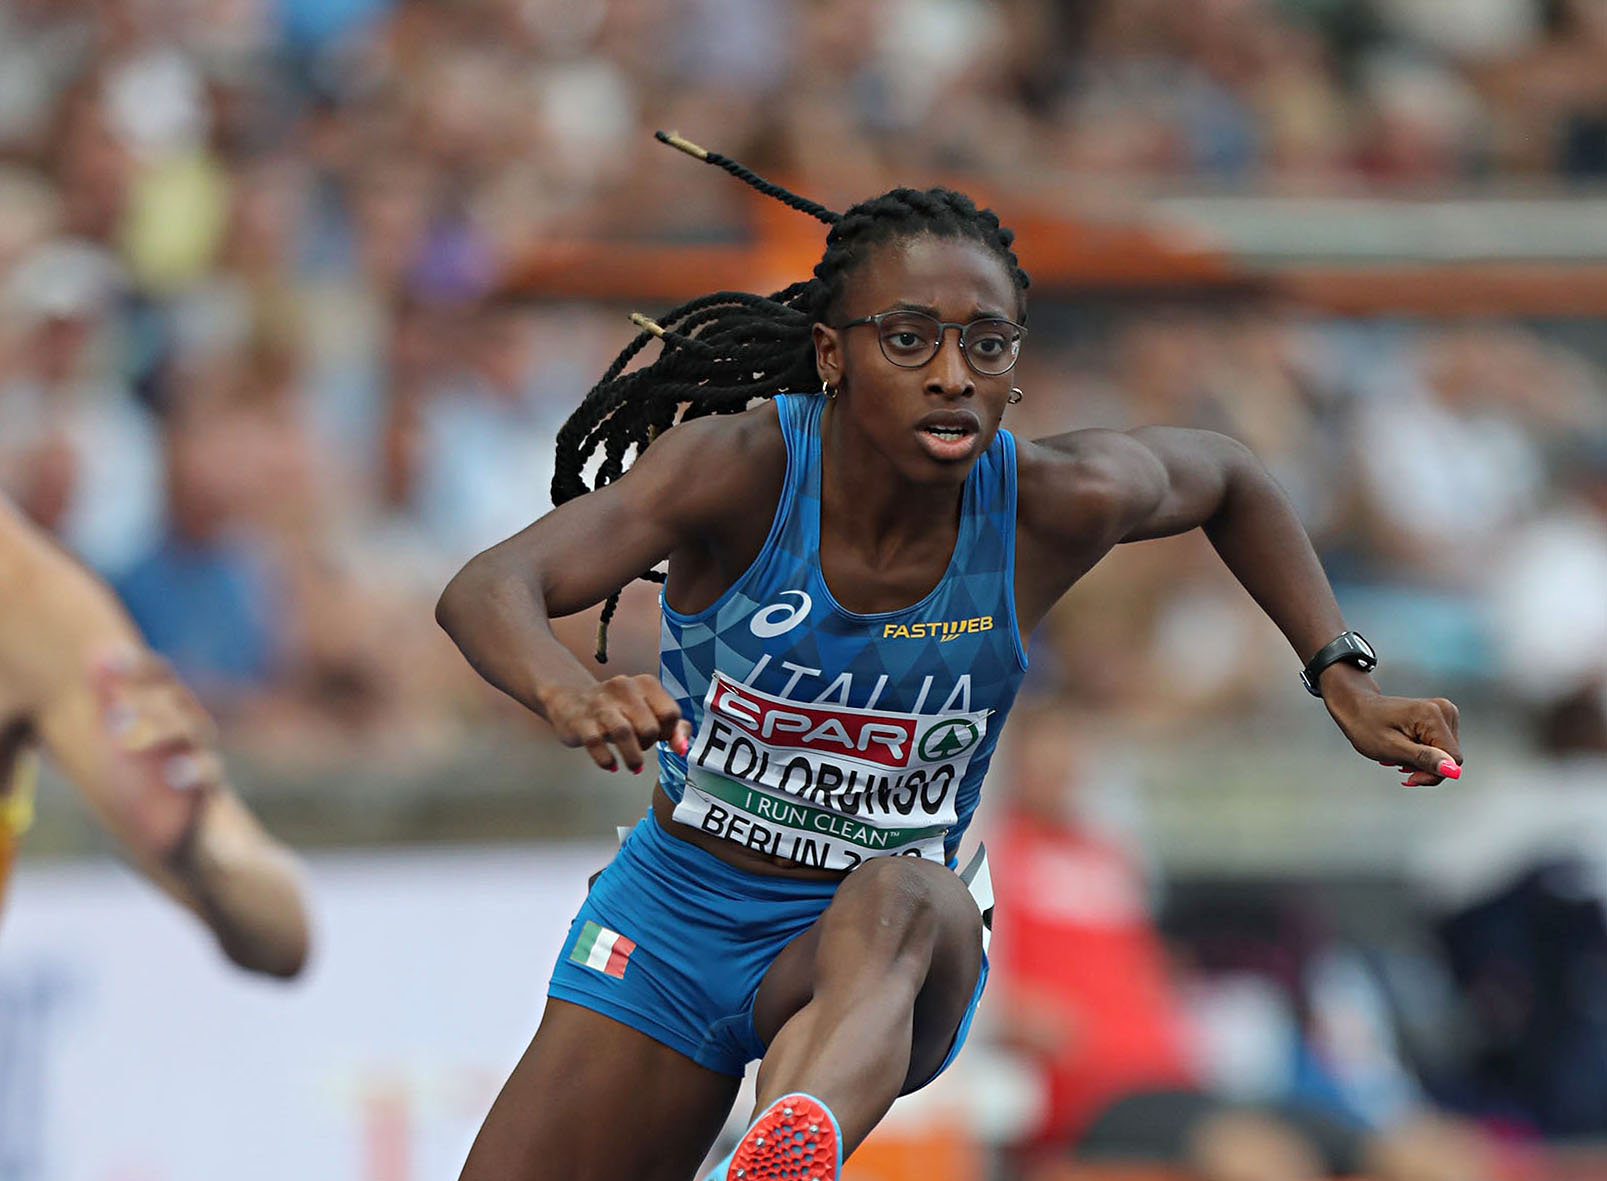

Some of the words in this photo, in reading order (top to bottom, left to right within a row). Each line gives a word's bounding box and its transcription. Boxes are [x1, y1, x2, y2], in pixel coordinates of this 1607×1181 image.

[883, 616, 994, 642] FASTWEB
[741, 653, 972, 716] ITALIA
[717, 690, 909, 760] SPAR
[697, 719, 955, 816] FOLORUNSO
[701, 803, 831, 871] BERLIN
[745, 791, 752, 809] I
[757, 796, 807, 826] RUN
